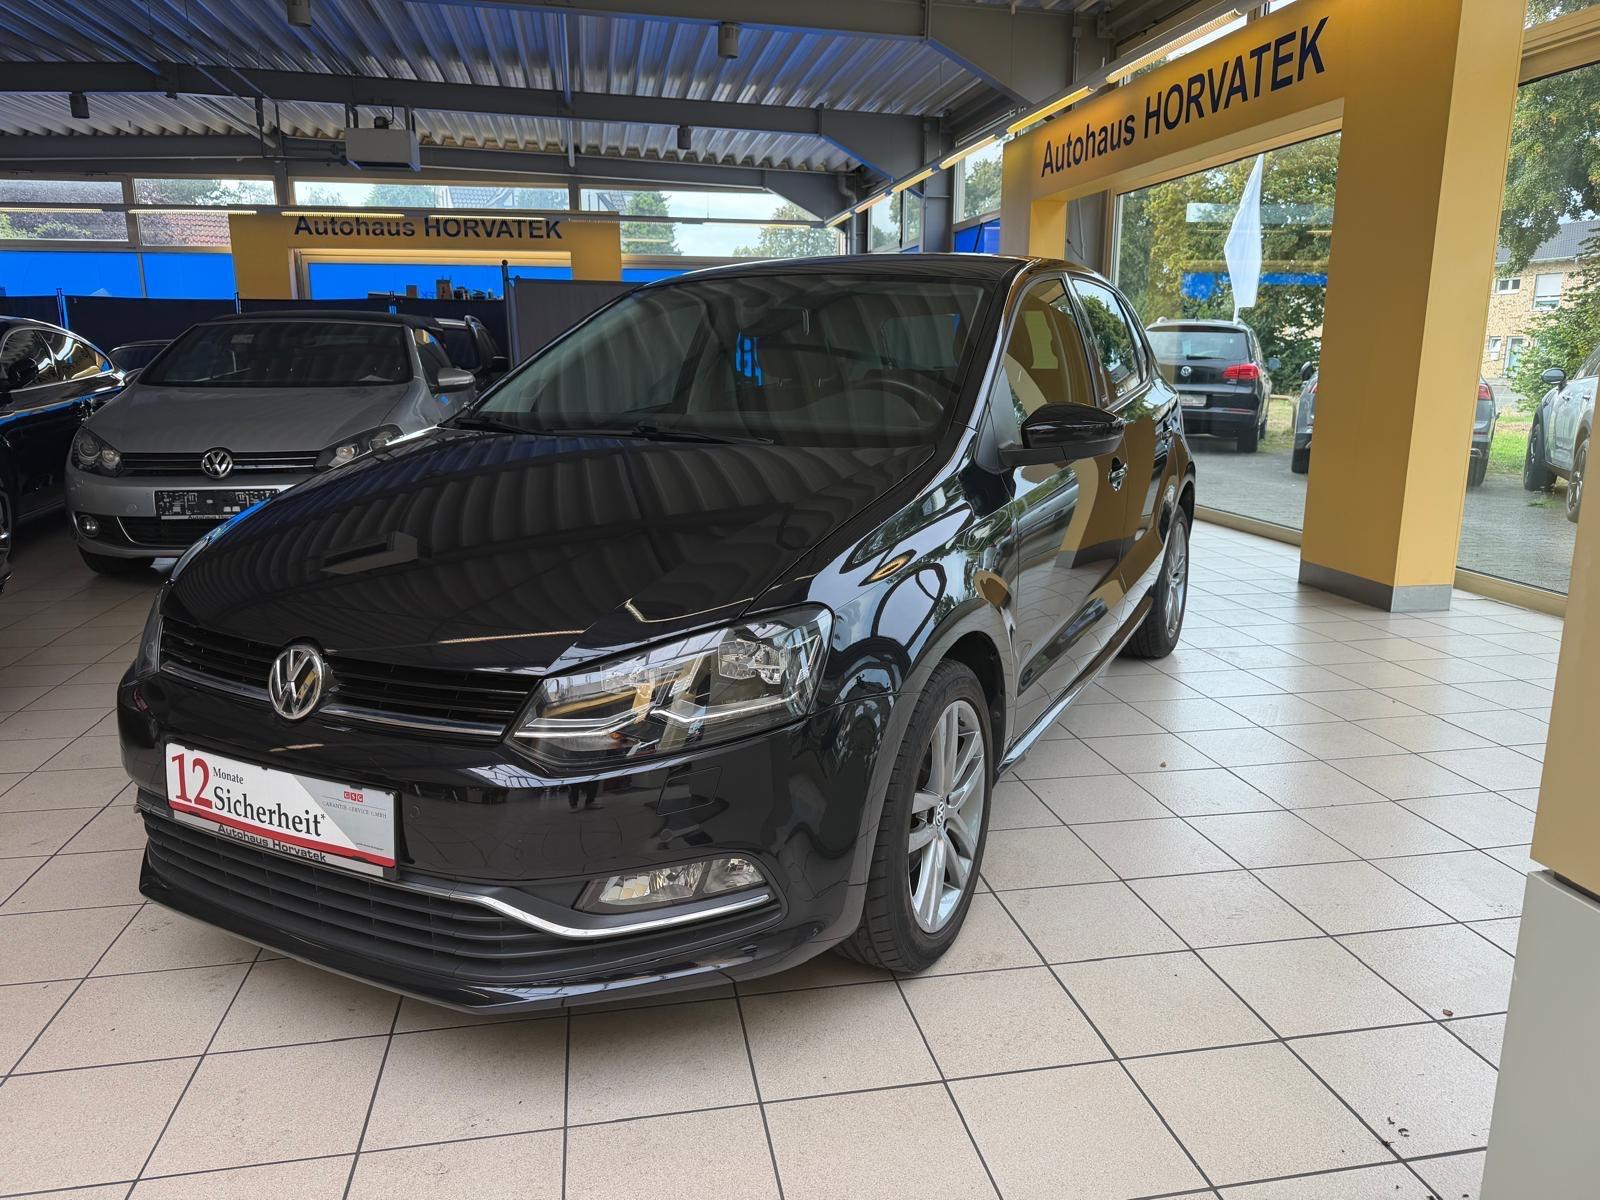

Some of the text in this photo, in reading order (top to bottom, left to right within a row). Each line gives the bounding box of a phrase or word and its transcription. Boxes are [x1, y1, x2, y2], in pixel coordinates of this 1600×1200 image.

[1041, 16, 1329, 177] Autohaus HORVATEK
[294, 216, 562, 239] Autohaus HORVATEK
[172, 753, 213, 809] 12
[213, 766, 244, 784] Monate
[218, 824, 327, 862] Autohaus Horvatek
